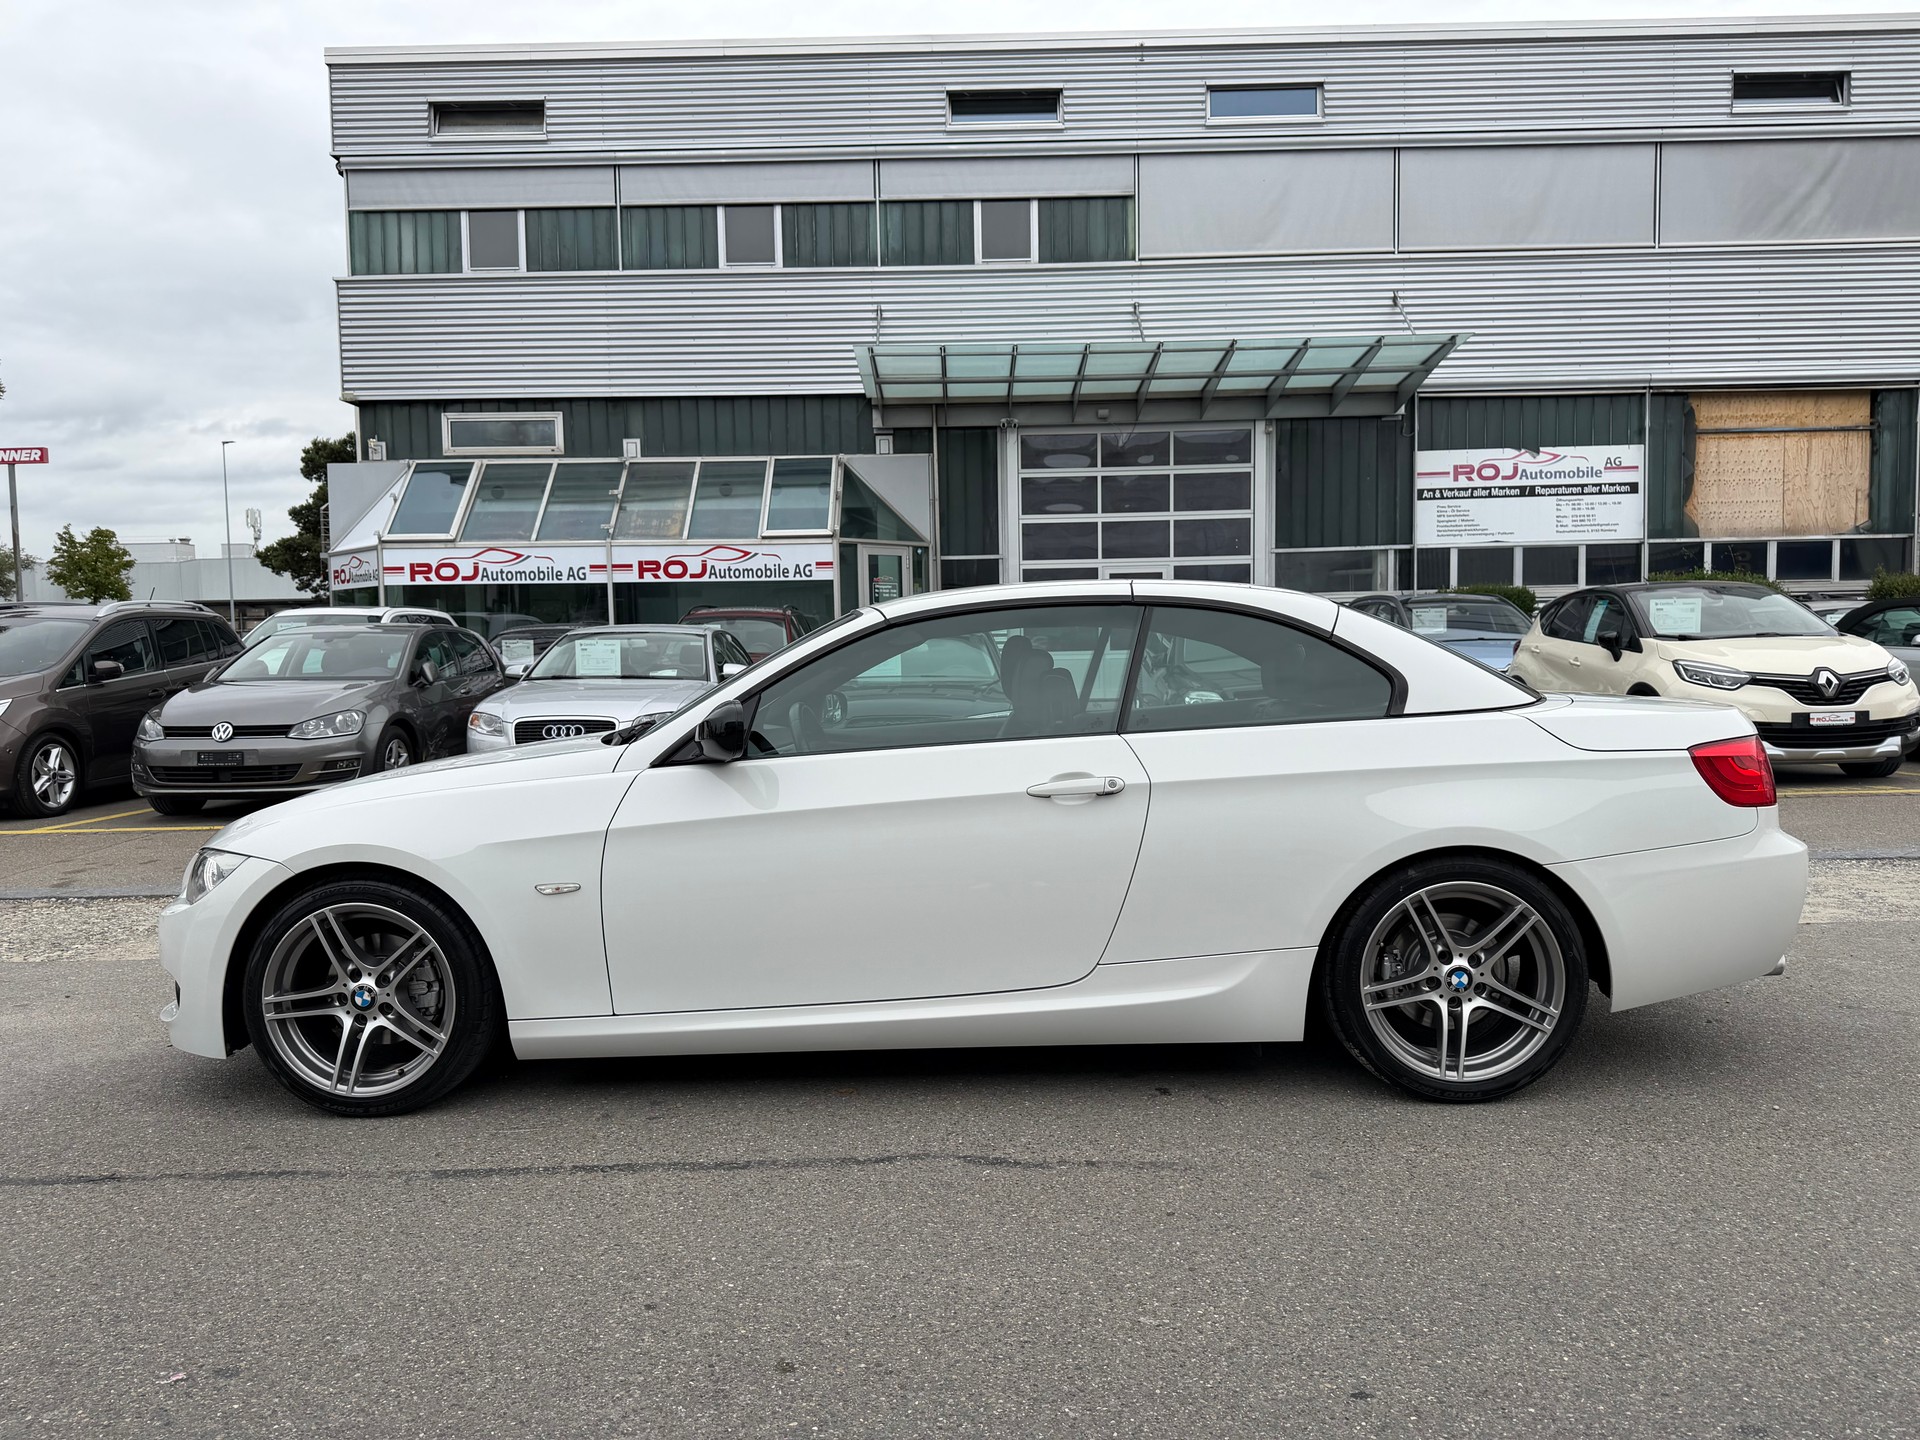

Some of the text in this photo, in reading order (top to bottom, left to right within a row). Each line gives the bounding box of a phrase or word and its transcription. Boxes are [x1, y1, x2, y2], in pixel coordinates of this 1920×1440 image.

[1452, 456, 1623, 482] ROJ Automobile AG
[1422, 489, 1433, 499] An
[1434, 489, 1441, 498] &
[1441, 488, 1471, 498] Verkauf
[1472, 488, 1489, 497] aller
[1490, 487, 1520, 496] Marken
[1535, 486, 1582, 496] Reparaturen
[1583, 485, 1600, 494] aller
[1601, 484, 1631, 493] Marken
[333, 567, 351, 585] ROJ
[409, 562, 587, 582] ROJ Automobile AG
[637, 559, 813, 579] ROJ Automobile AG
